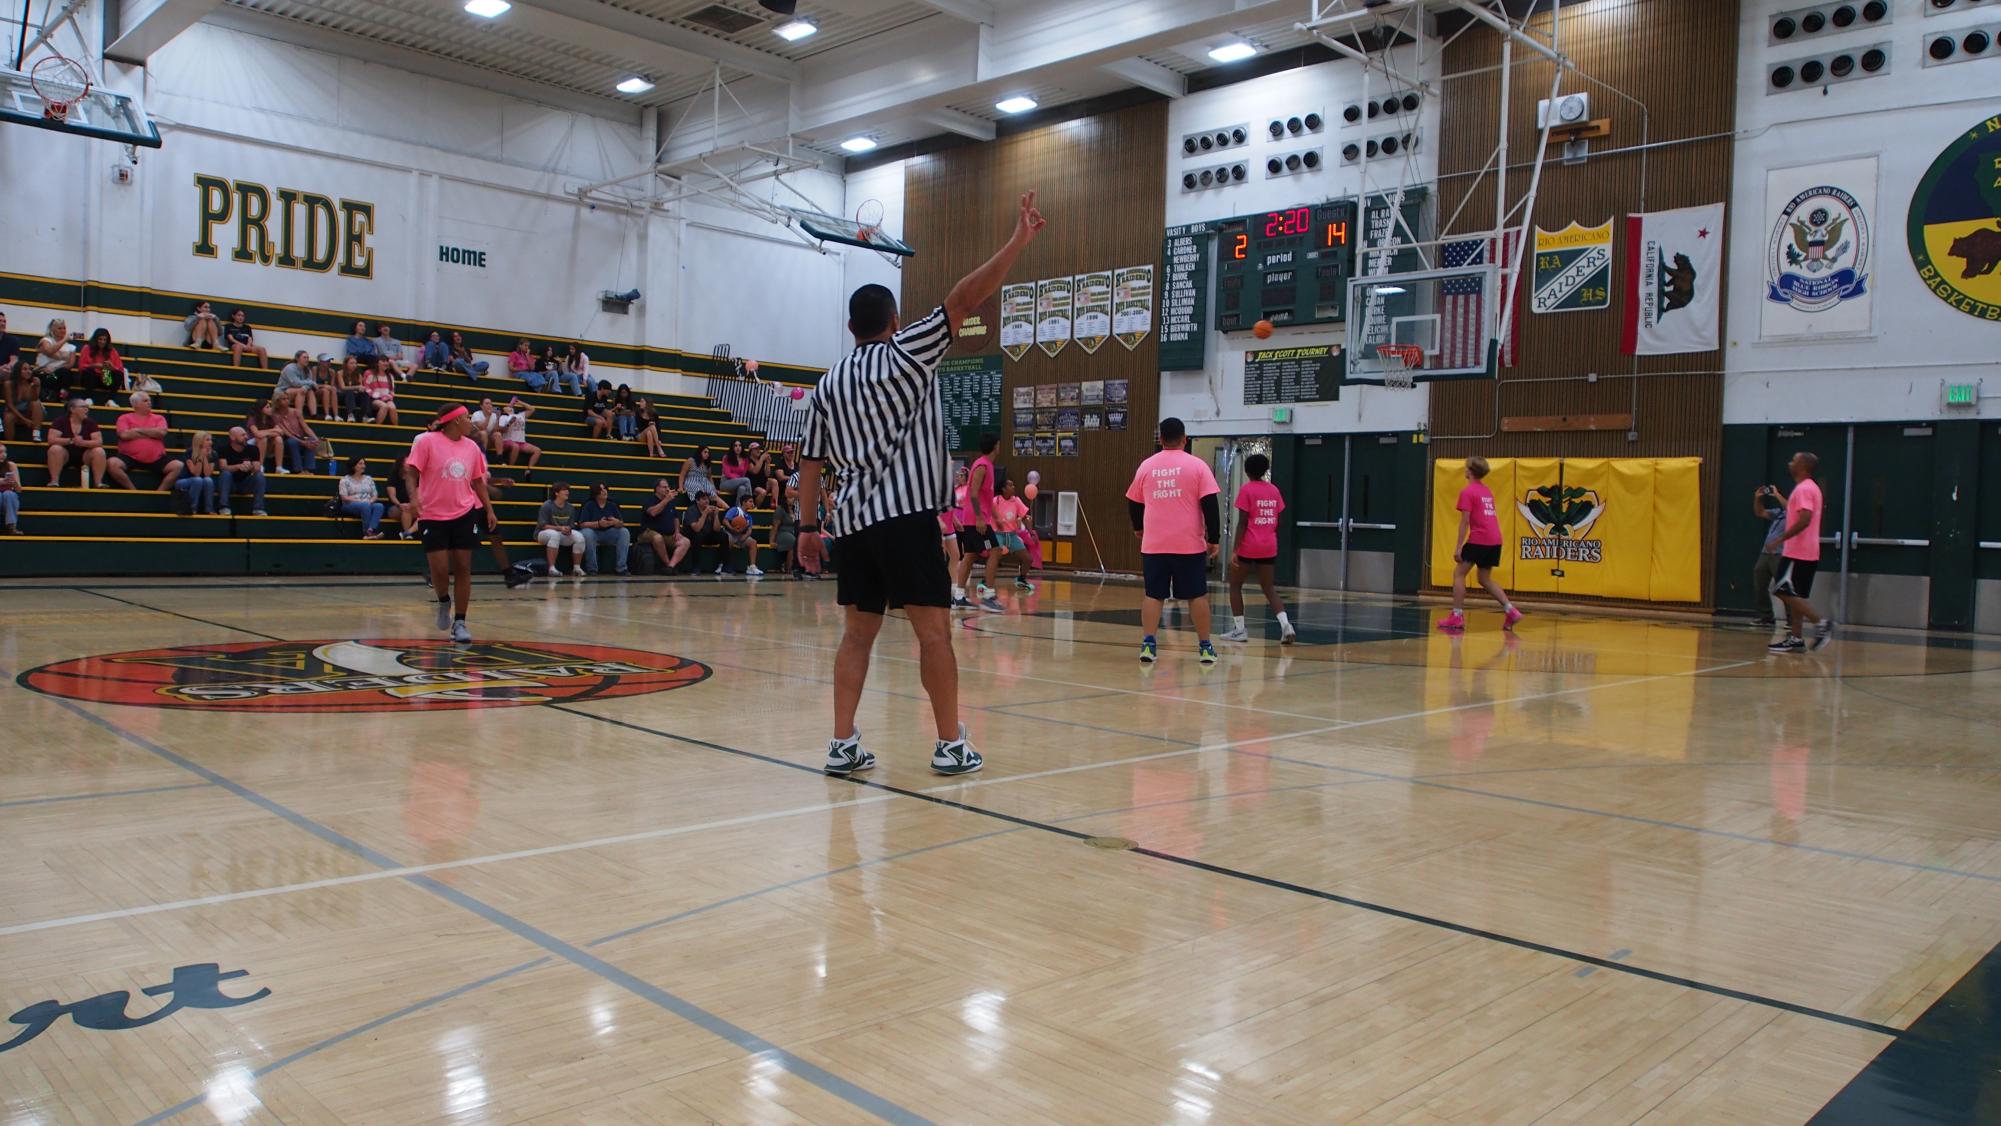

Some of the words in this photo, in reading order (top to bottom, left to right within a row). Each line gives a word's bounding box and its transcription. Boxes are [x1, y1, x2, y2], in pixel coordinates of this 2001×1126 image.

[1388, 192, 1406, 203] BOS
[192, 172, 374, 280] PRIDE
[1191, 223, 1206, 233] BOYS
[1265, 208, 1309, 237] 2:20
[1327, 222, 1347, 246] 14
[1538, 237, 1555, 247] RIO
[1556, 231, 1610, 244] AMERICANO
[1235, 234, 1248, 258] 2
[1267, 251, 1293, 266] period
[1538, 255, 1562, 272] RA
[1645, 240, 1655, 287] CALIFORNIA
[1267, 271, 1293, 284] player
[1537, 249, 1606, 308] RAIDERS
[1171, 289, 1196, 299] SULLIVAN
[1920, 265, 2001, 321] BASKETB
[1162, 299, 1170, 308] 10
[1644, 292, 1654, 329] REPUBLIC
[1256, 351, 1273, 362] JACK
[1273, 349, 1296, 361] SCOTT
[1296, 346, 1328, 359] TOURNEY
[1152, 467, 1182, 478] FIGHT
[1157, 479, 1177, 489] THE
[1256, 499, 1278, 508] FIGHT
[1259, 508, 1274, 517] THE
[1521, 537, 1539, 547] RIO
[1541, 538, 1601, 548] AMERICANO
[1521, 546, 1602, 563] RAIDERS
[165, 661, 668, 702] RAIDERS
